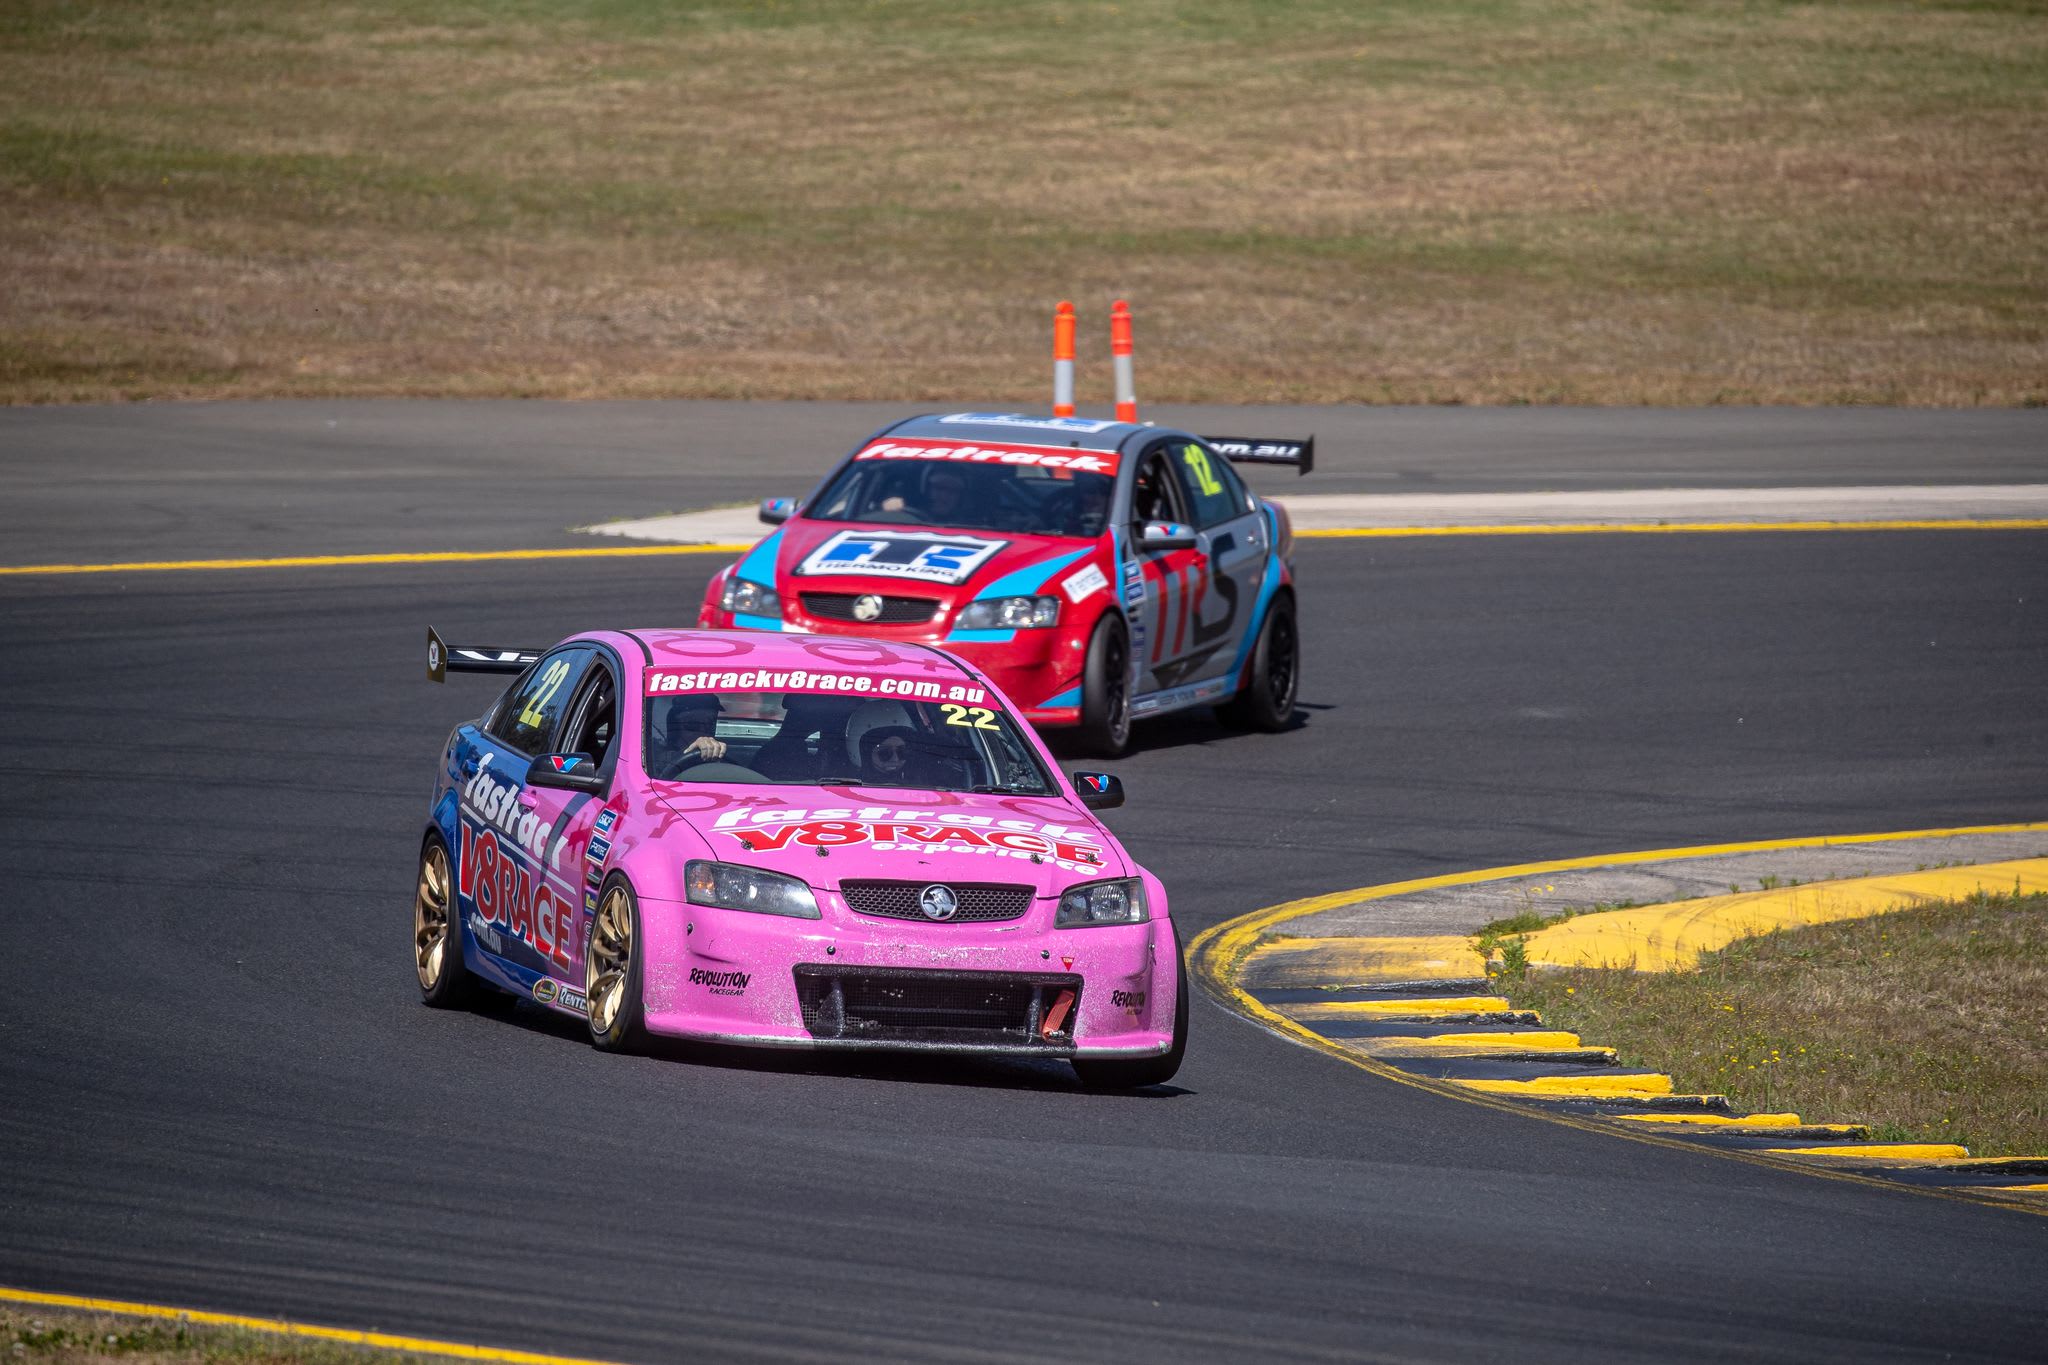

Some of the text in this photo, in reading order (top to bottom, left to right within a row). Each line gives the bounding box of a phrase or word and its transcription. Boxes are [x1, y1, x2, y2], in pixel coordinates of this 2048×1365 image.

[858, 443, 1112, 471] fastrack
[1183, 443, 1223, 497] 12
[815, 561, 956, 577] THERMO KING
[519, 659, 570, 729] 22
[650, 670, 985, 703] fastrackv8race.com.au
[940, 704, 1000, 731] 22
[598, 813, 614, 827] SKF
[714, 808, 1100, 844] fastrack
[720, 820, 1107, 868] V8RACE
[871, 843, 1098, 875] experience
[460, 818, 574, 975] V8RACE
[689, 968, 751, 988] REVOLUTION
[709, 987, 745, 997] RACEGEAR
